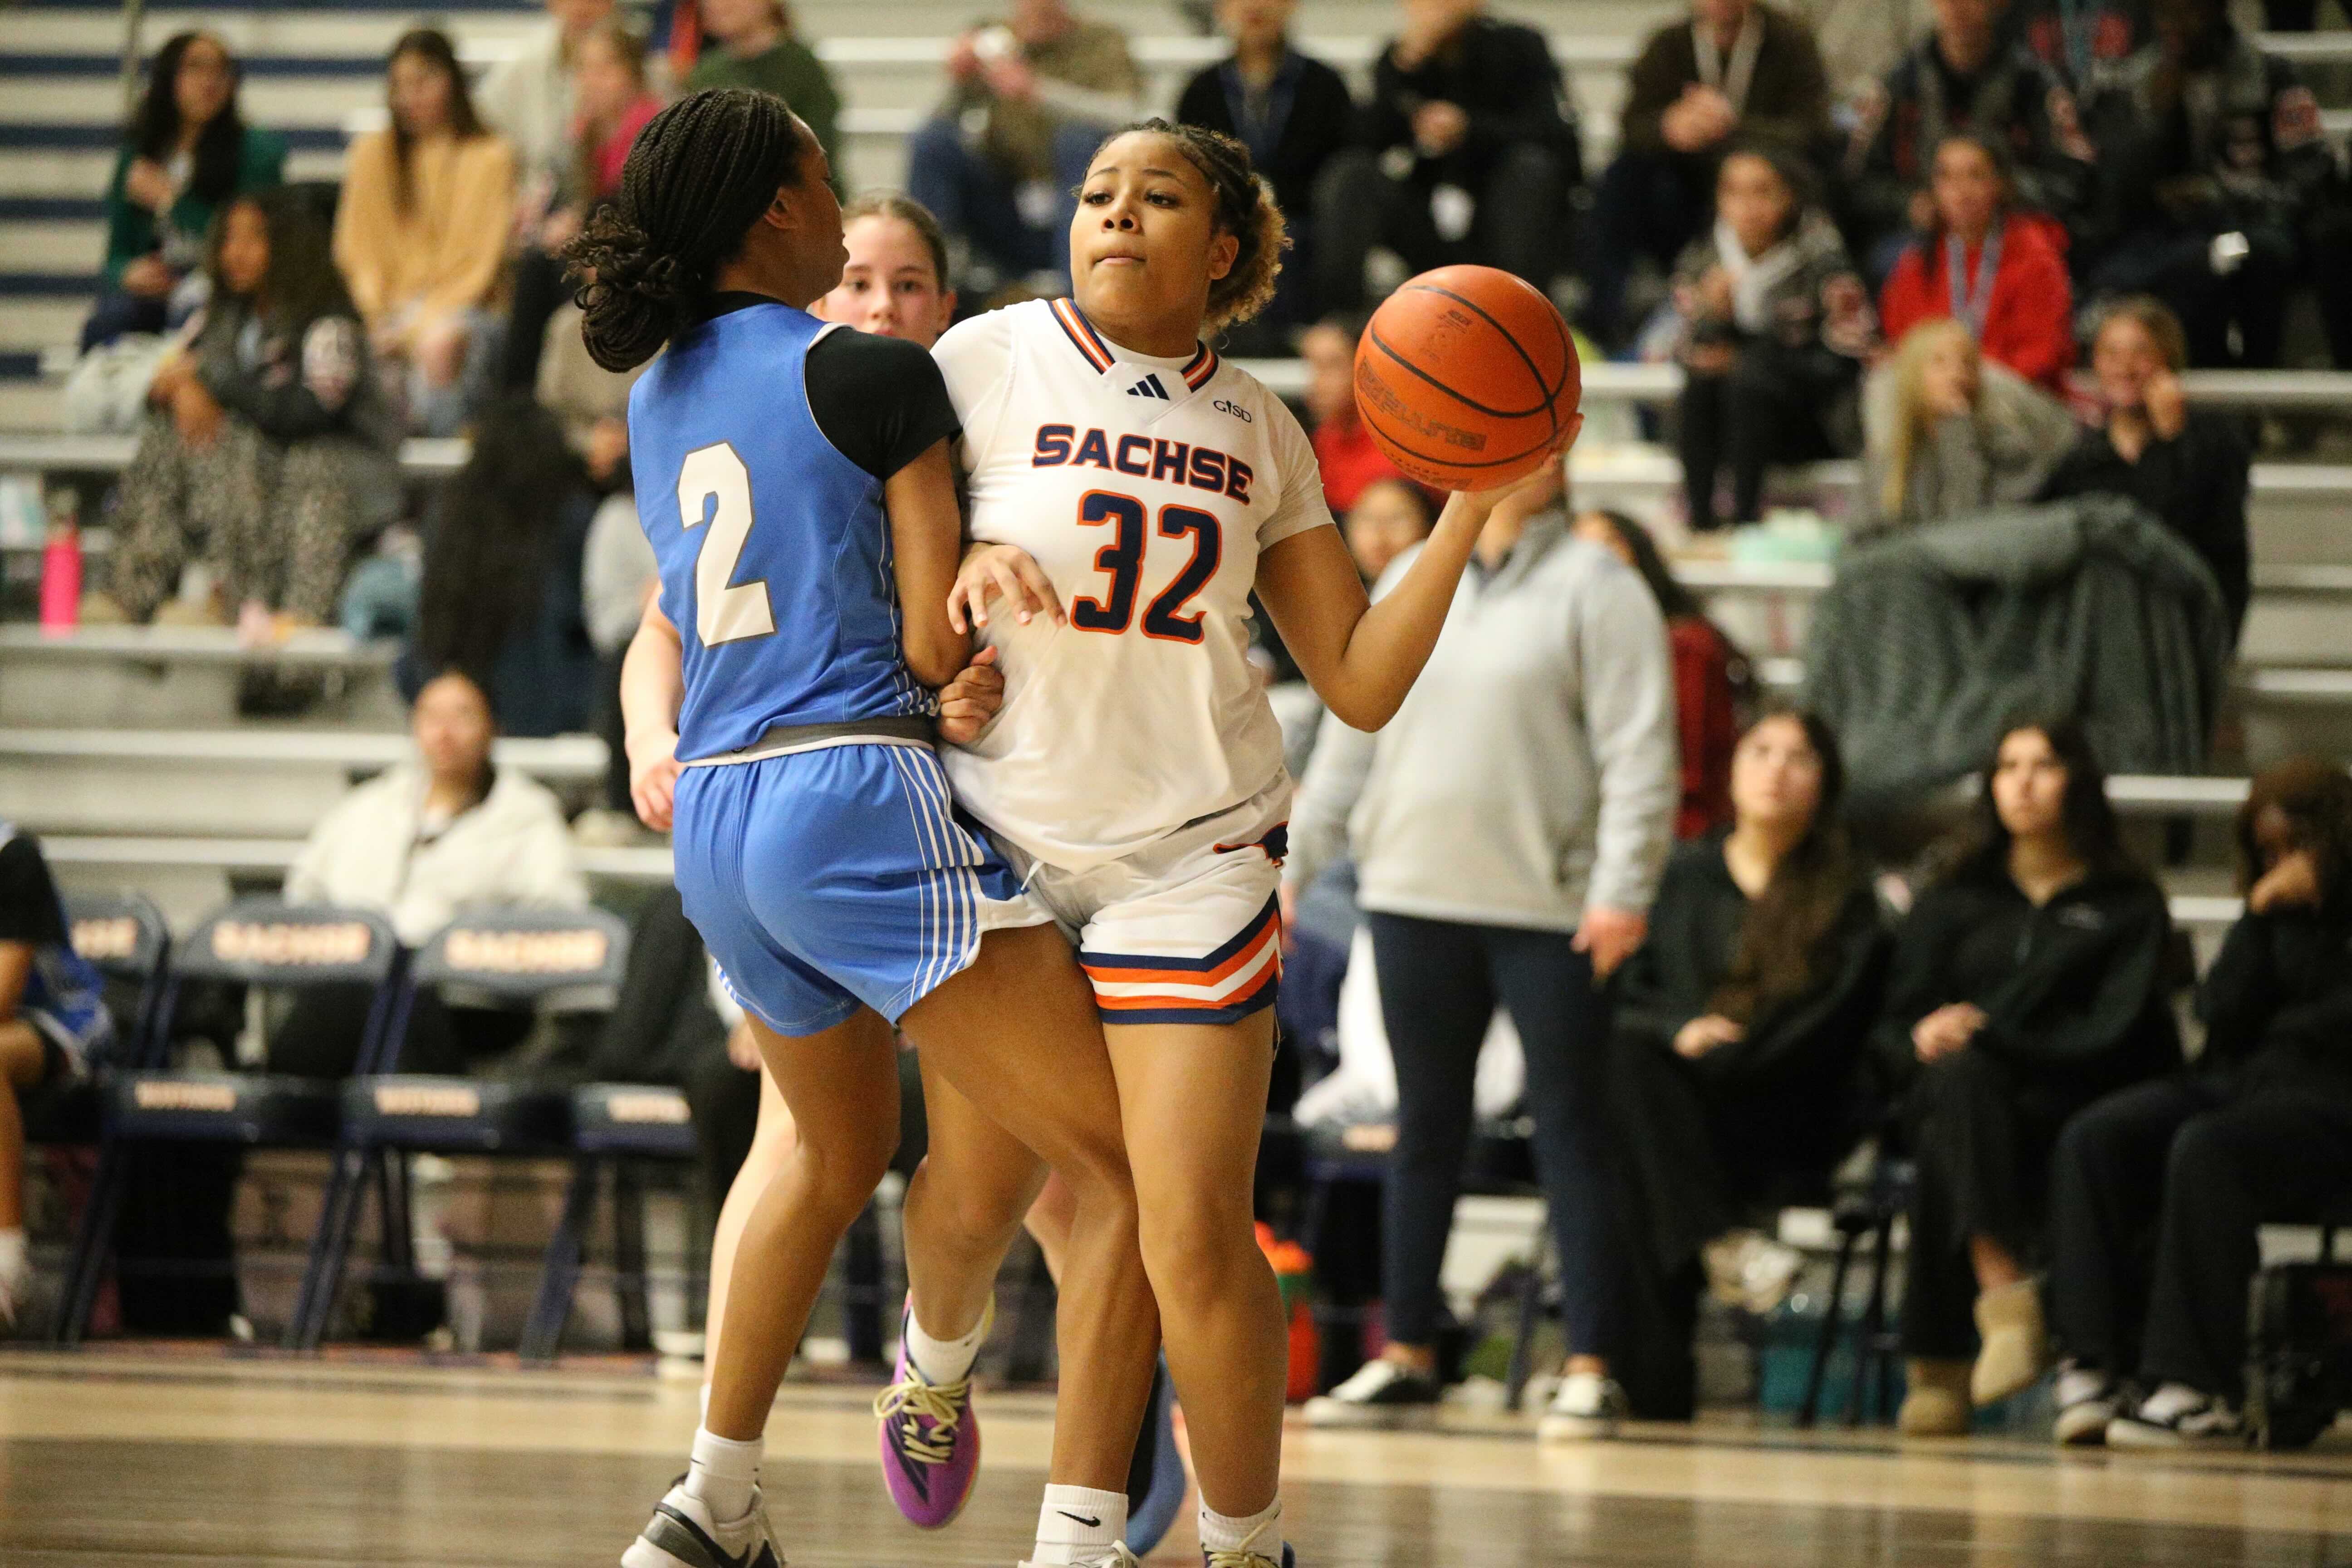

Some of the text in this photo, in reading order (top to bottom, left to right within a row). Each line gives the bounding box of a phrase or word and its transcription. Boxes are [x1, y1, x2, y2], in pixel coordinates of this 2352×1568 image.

[1031, 423, 1254, 506] SACHSE
[677, 440, 779, 649] 2
[1070, 489, 1223, 645] 32
